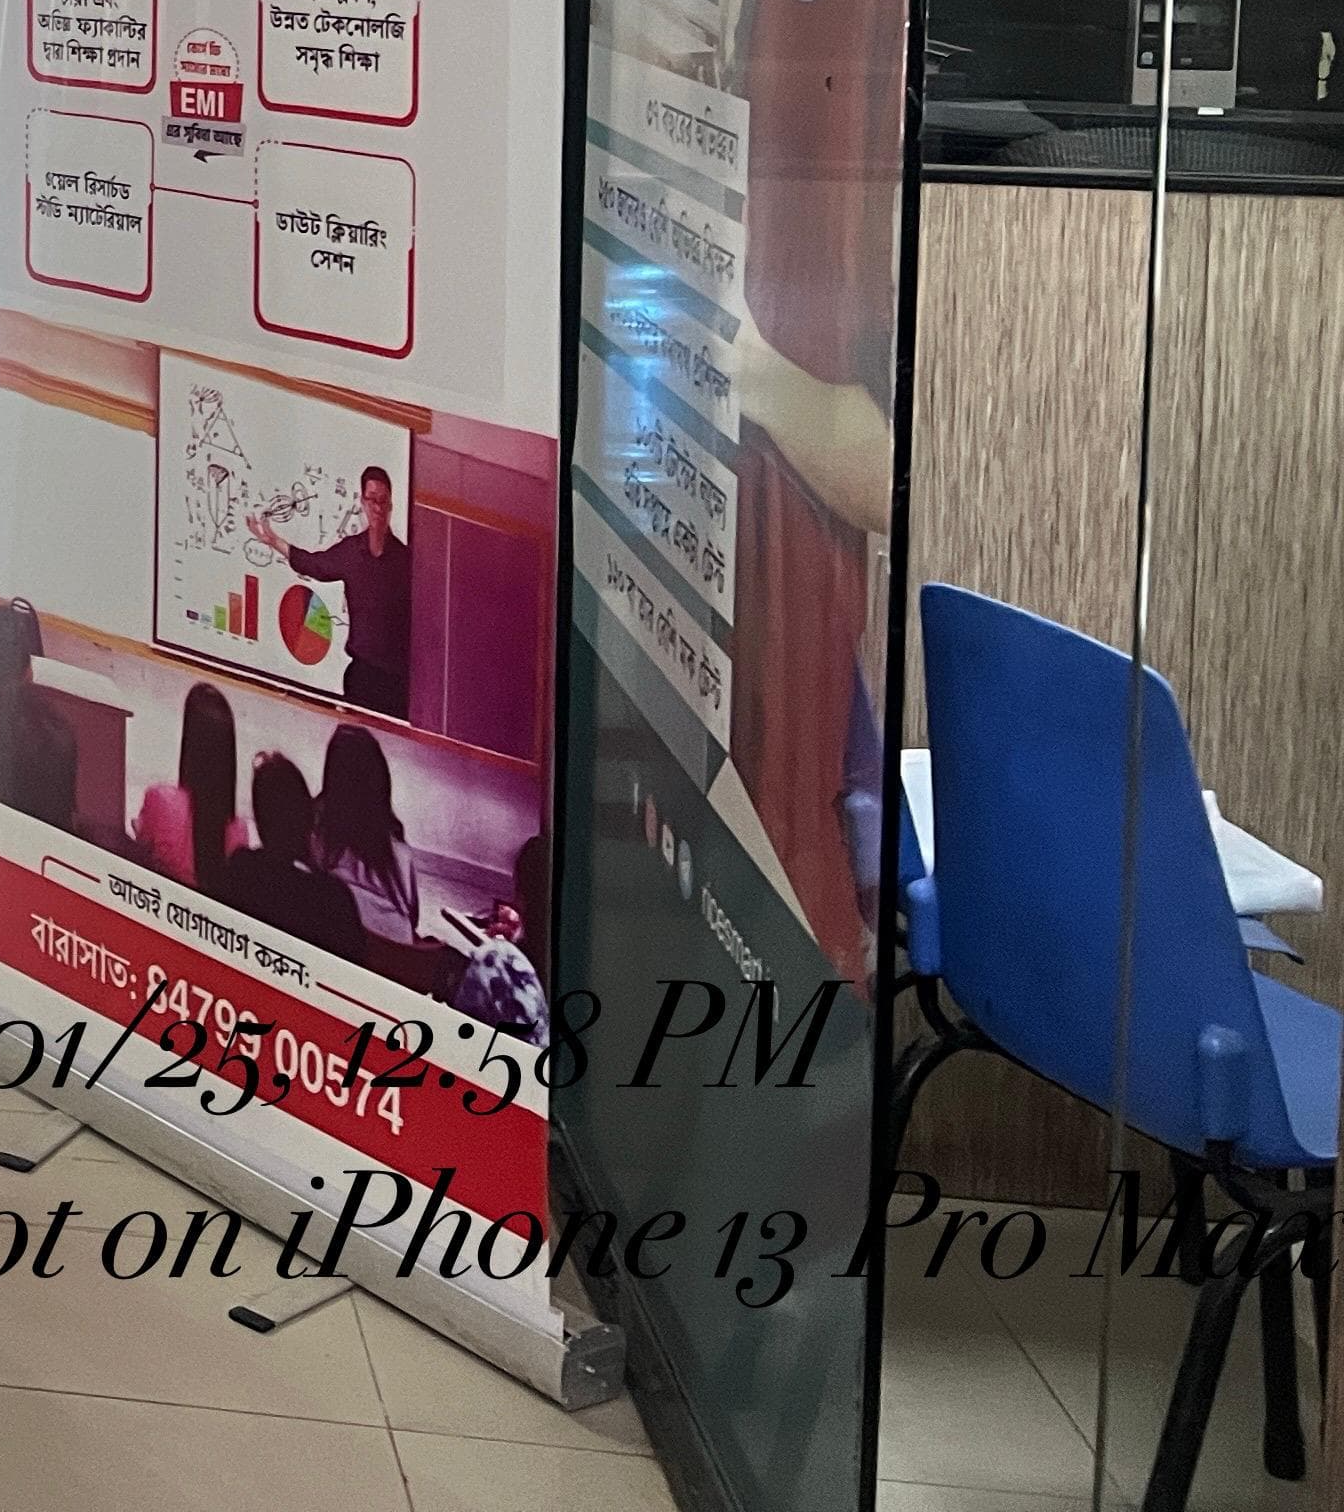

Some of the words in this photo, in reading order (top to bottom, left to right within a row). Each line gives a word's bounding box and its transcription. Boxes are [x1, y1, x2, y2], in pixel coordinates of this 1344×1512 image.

[180, 87, 225, 119] EMI
[143, 961, 264, 1065] 84799
[271, 1024, 406, 1137] 00574
